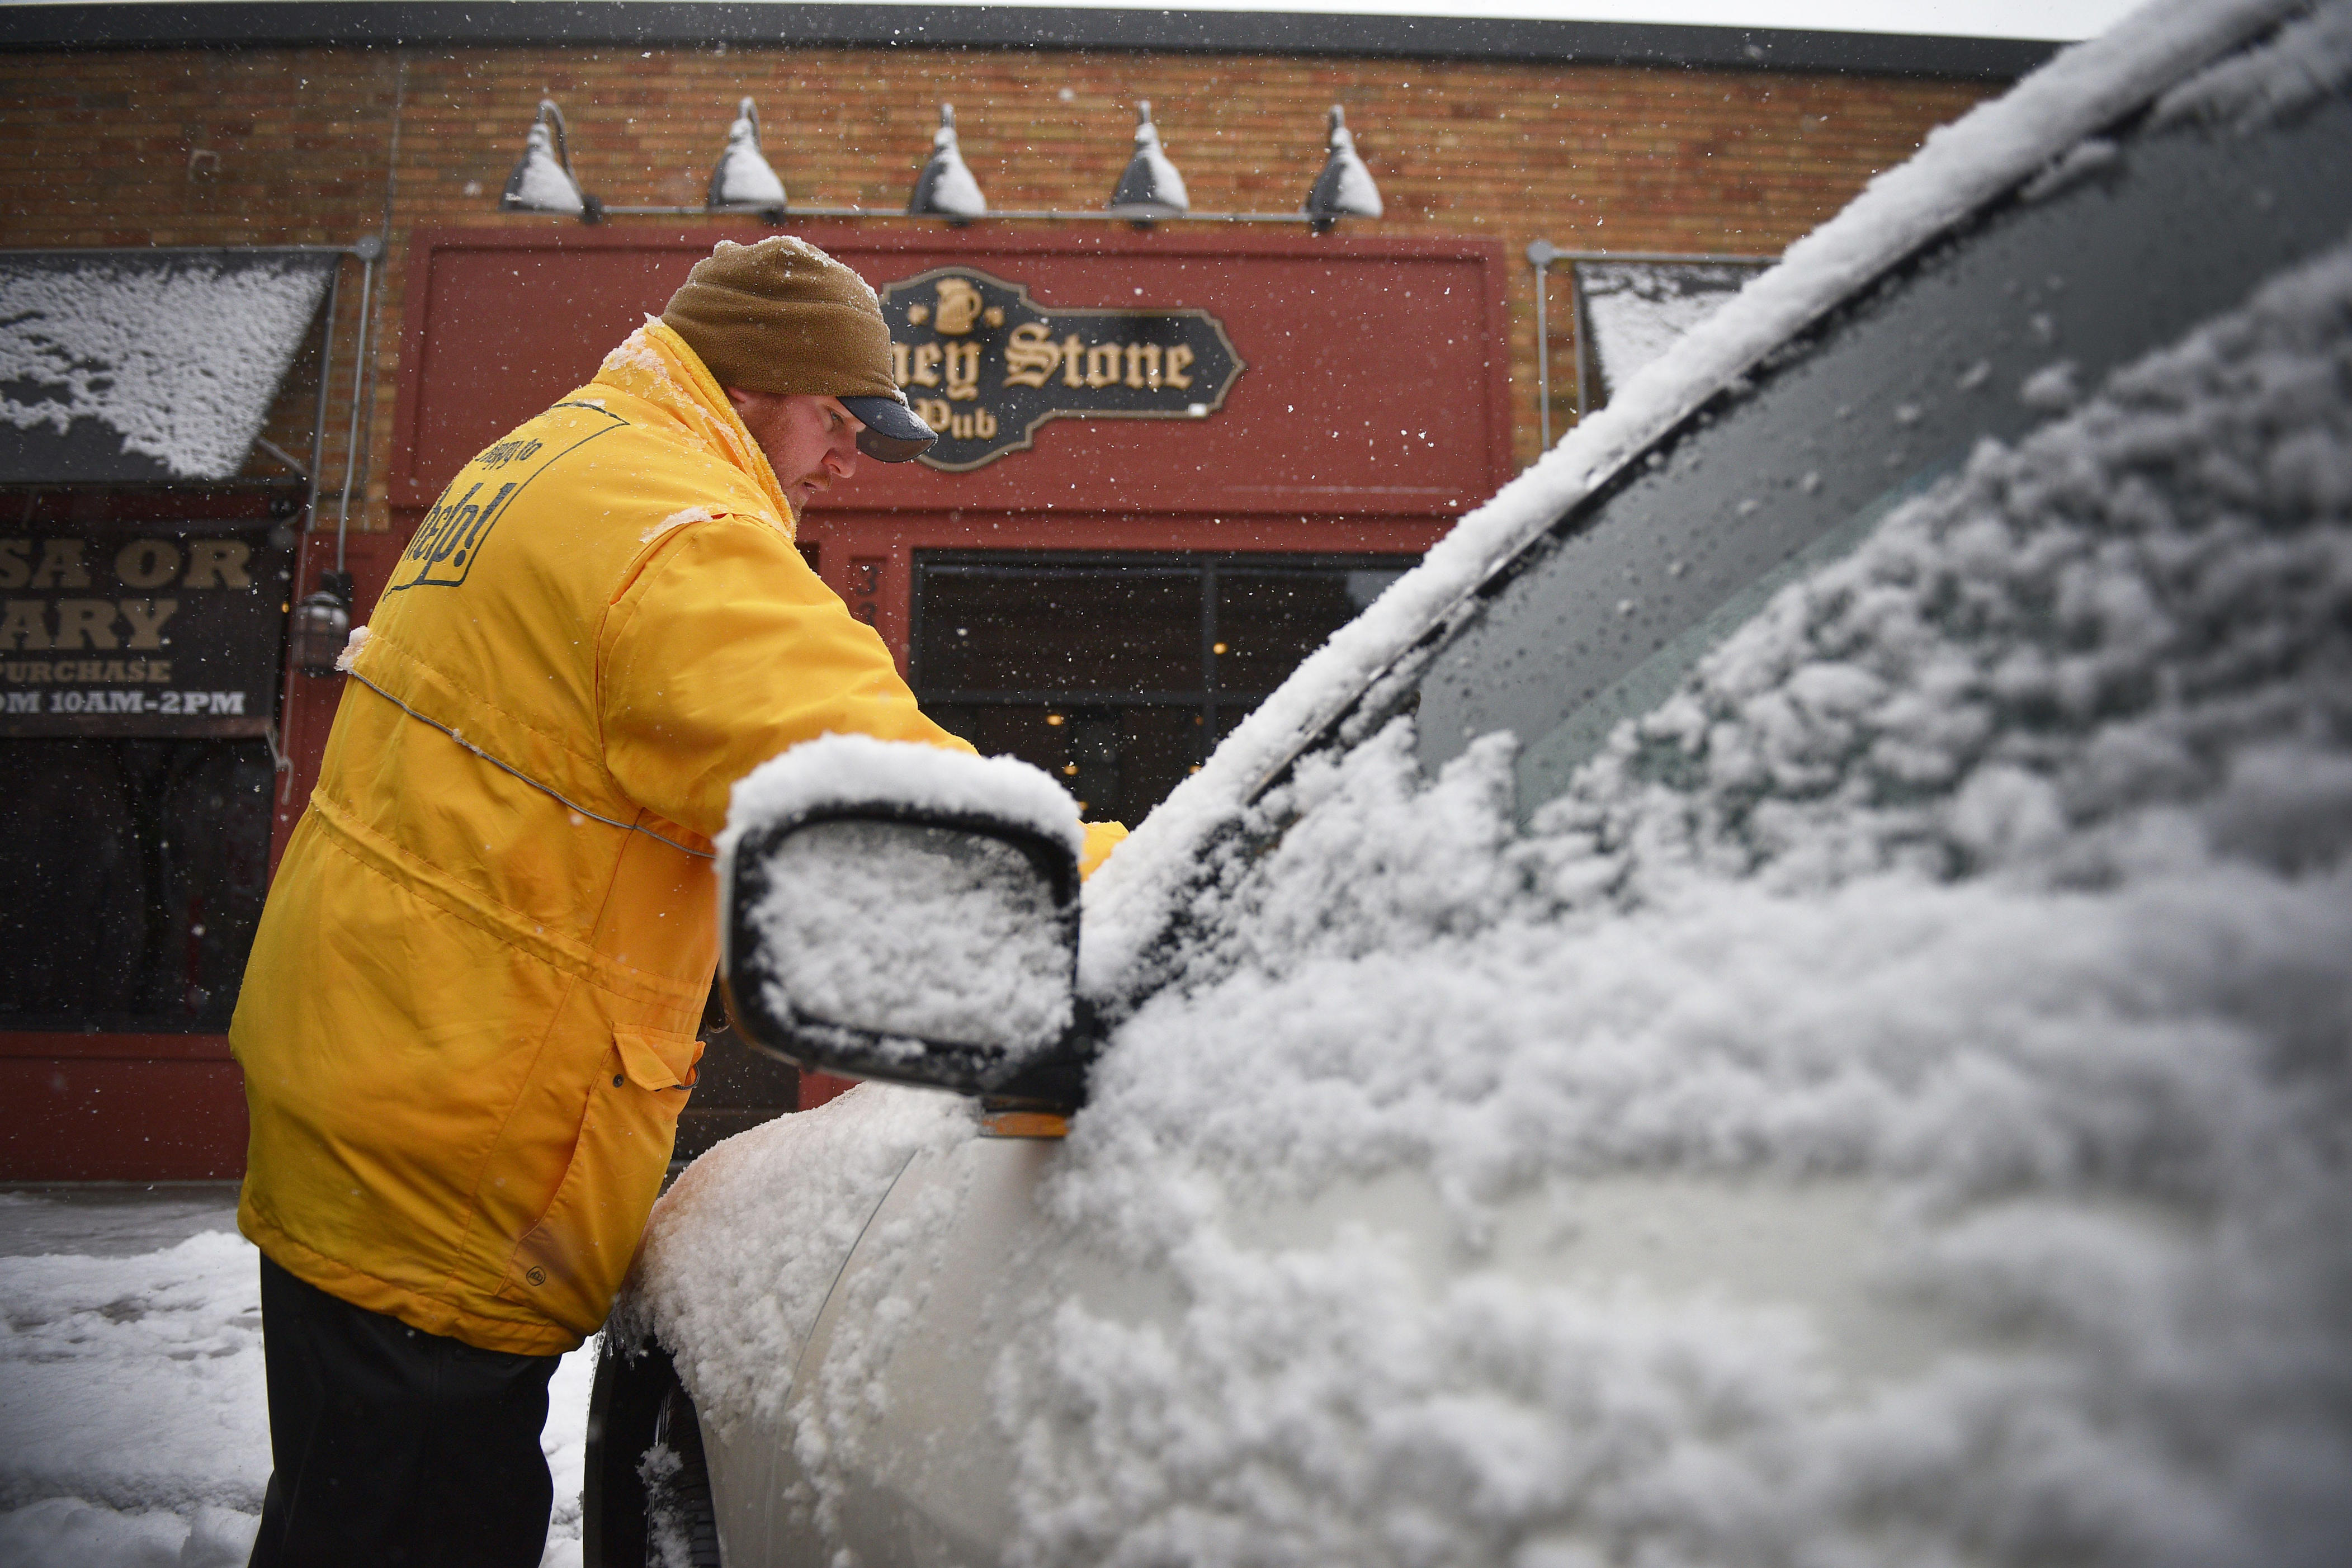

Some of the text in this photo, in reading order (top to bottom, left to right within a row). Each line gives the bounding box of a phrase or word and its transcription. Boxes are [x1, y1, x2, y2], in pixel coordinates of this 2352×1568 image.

[1003, 322, 1196, 390] Stone
[913, 398, 998, 440] Pub
[514, 438, 544, 461] to
[115, 539, 252, 590] OR
[0, 598, 178, 650] ARY
[0, 660, 172, 683] URCHASE
[0, 691, 246, 715] M 10AM-2PM
